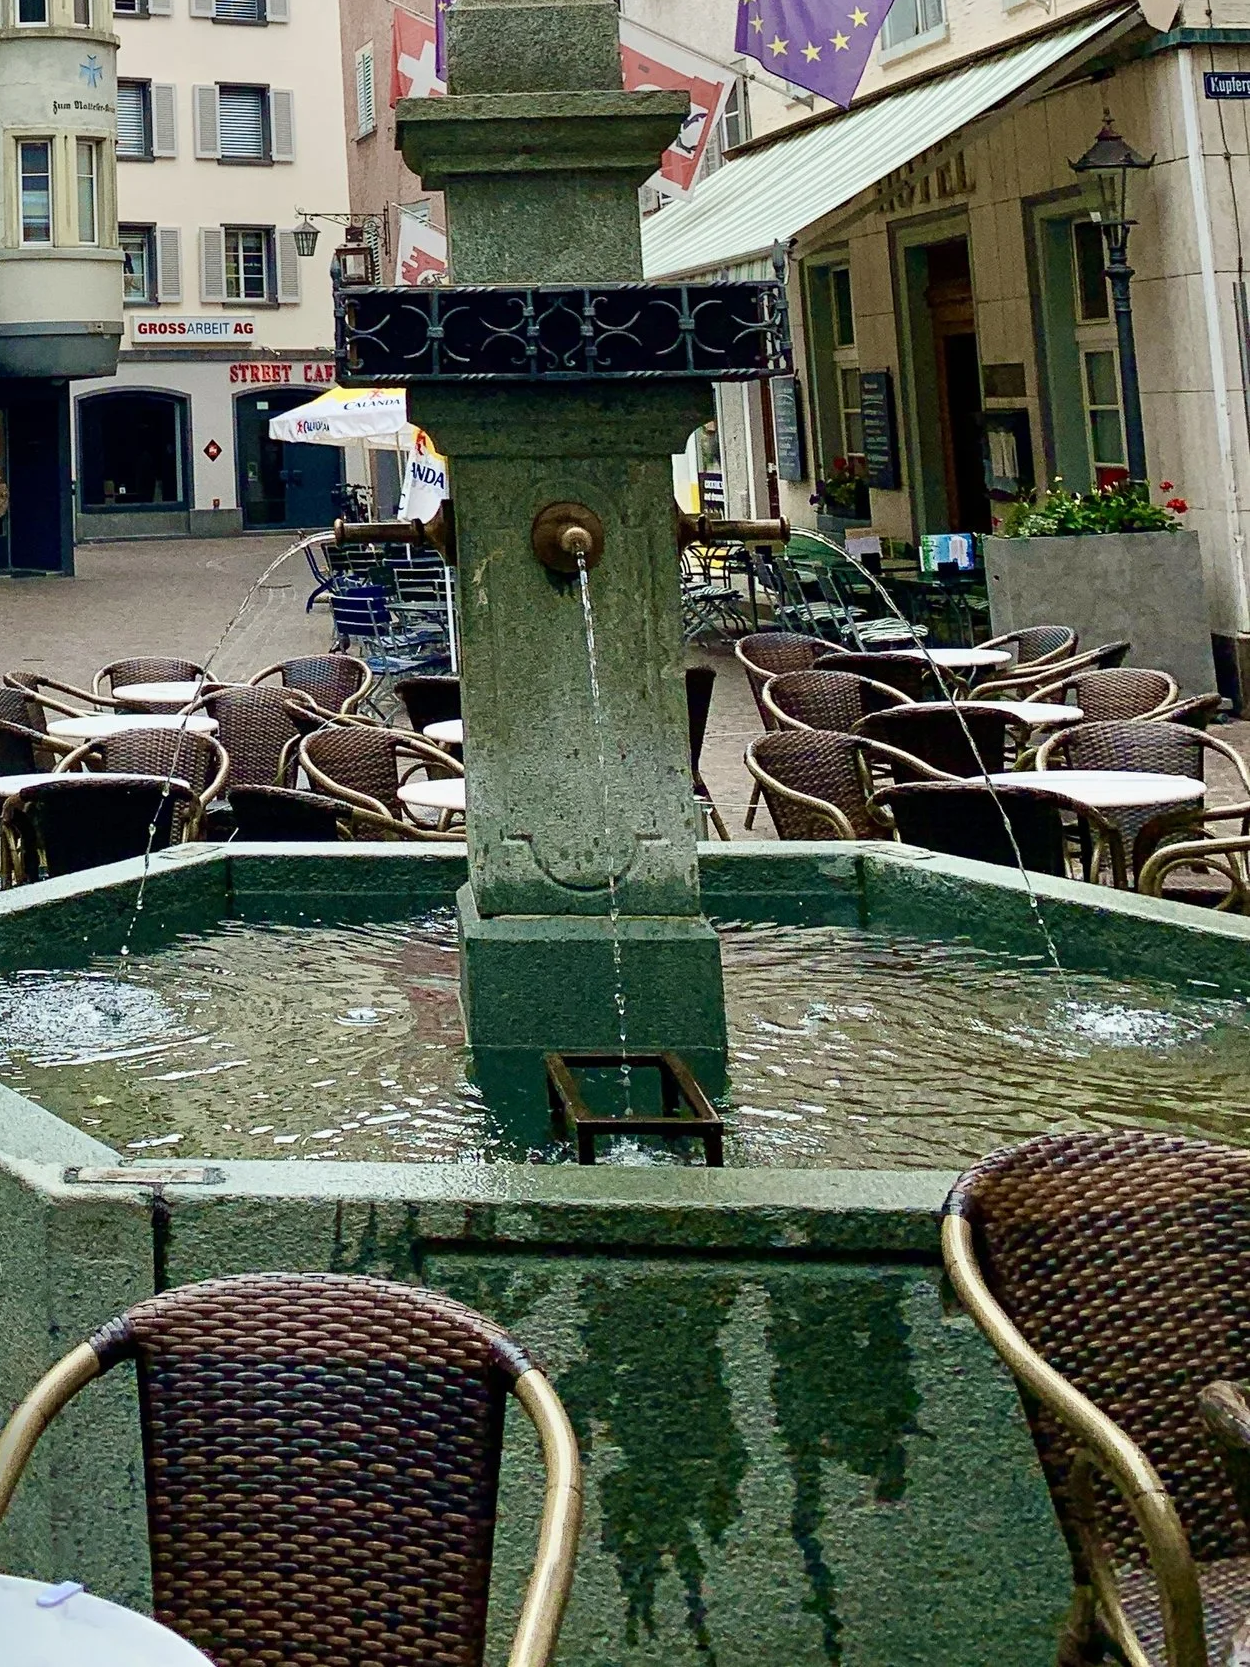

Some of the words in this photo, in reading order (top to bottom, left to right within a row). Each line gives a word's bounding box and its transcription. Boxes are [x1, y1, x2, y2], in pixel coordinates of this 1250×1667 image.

[137, 322, 230, 335] GROSSARBEIT
[233, 323, 254, 334] AG
[229, 363, 292, 383] STREET
[304, 364, 336, 383] CAF
[343, 398, 401, 411] CALANDA
